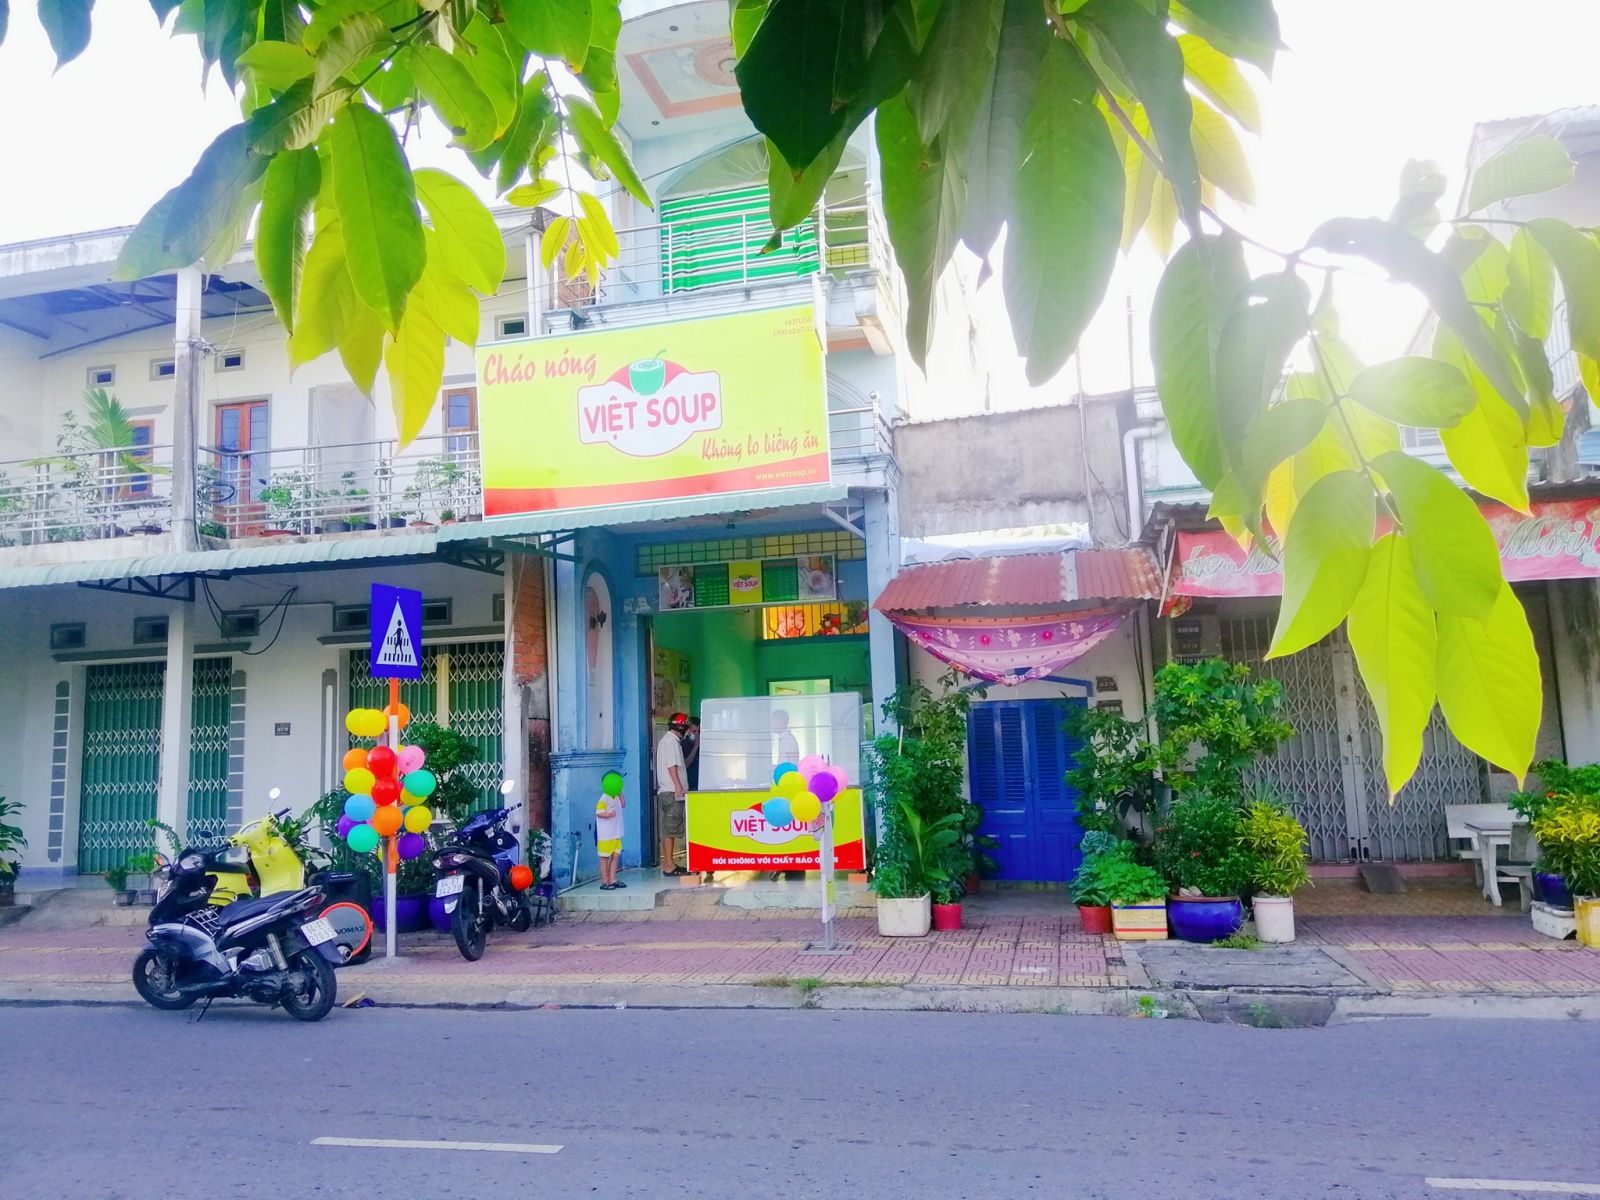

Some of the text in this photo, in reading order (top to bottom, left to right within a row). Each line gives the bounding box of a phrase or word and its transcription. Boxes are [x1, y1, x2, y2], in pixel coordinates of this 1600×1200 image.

[483, 347, 597, 386] Cháo nóng
[583, 392, 717, 440] VIỆT SOUP
[702, 437, 743, 462] Không
[747, 433, 759, 456] lo
[802, 430, 819, 450] ăn
[755, 467, 817, 481] www.vietsoup.vn
[734, 816, 766, 836] VIỆT
[712, 855, 726, 865] NÓI
[728, 855, 755, 865] KHÔNG
